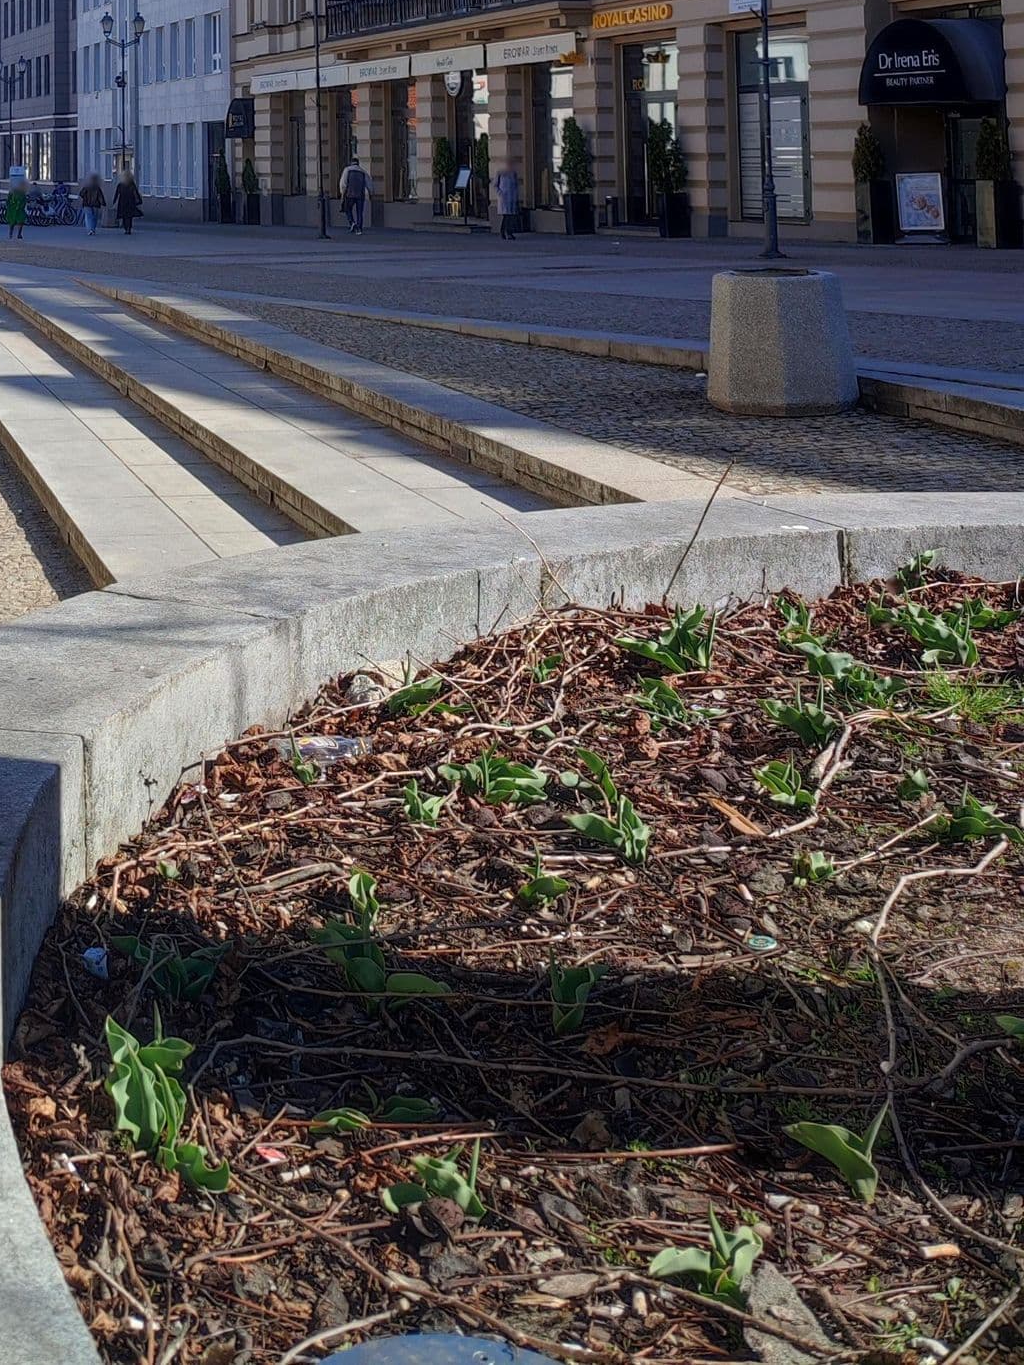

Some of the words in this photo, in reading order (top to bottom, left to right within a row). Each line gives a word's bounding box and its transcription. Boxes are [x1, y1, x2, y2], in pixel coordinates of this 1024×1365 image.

[592, 10, 626, 29] ROYAL
[625, 4, 668, 24] CASINO
[878, 53, 893, 69] Dr
[894, 51, 921, 68] Irena
[922, 48, 940, 66] Eris
[886, 77, 908, 87] BEAUTY
[909, 76, 935, 86] PARTNER
